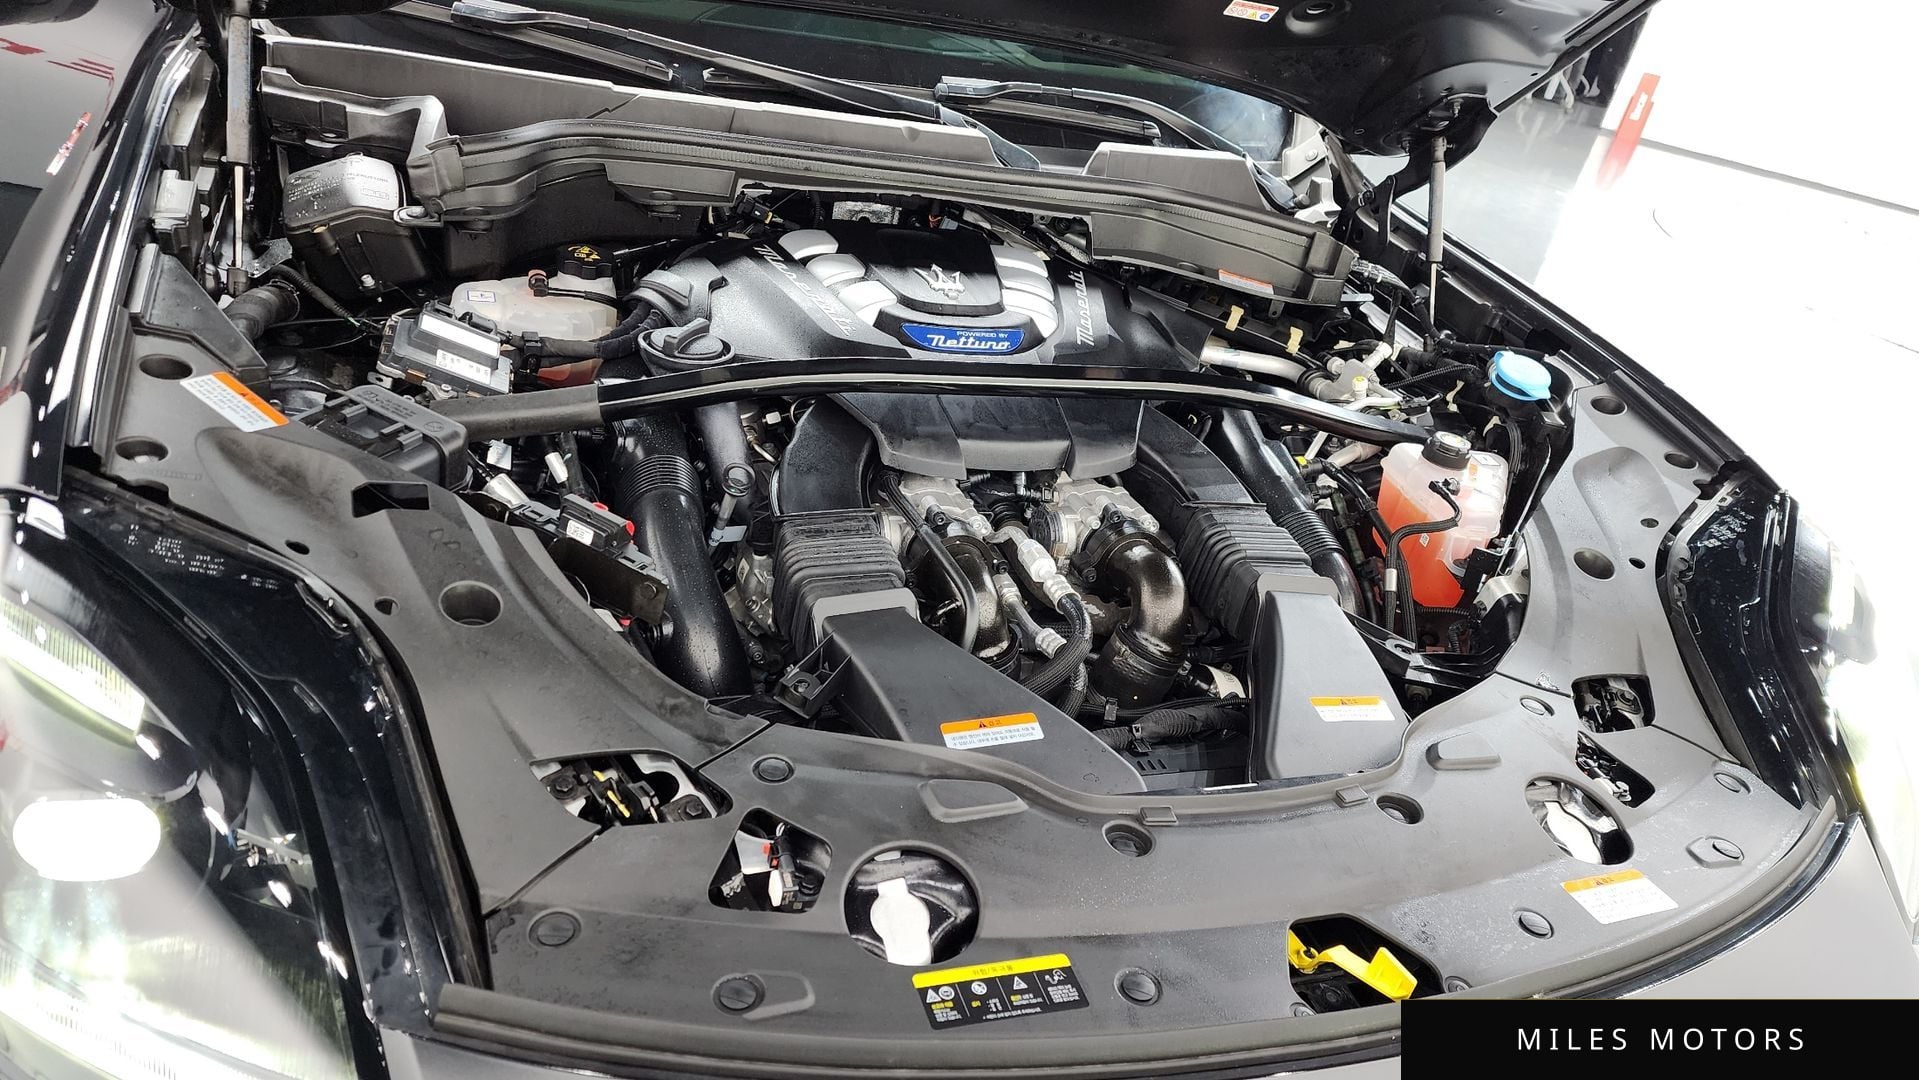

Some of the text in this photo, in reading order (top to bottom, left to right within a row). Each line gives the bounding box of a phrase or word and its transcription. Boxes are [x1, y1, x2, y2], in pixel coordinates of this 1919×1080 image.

[1068, 270, 1095, 346] Maserati
[926, 334, 1011, 350] Nettuno
[956, 330, 997, 338] POWERED
